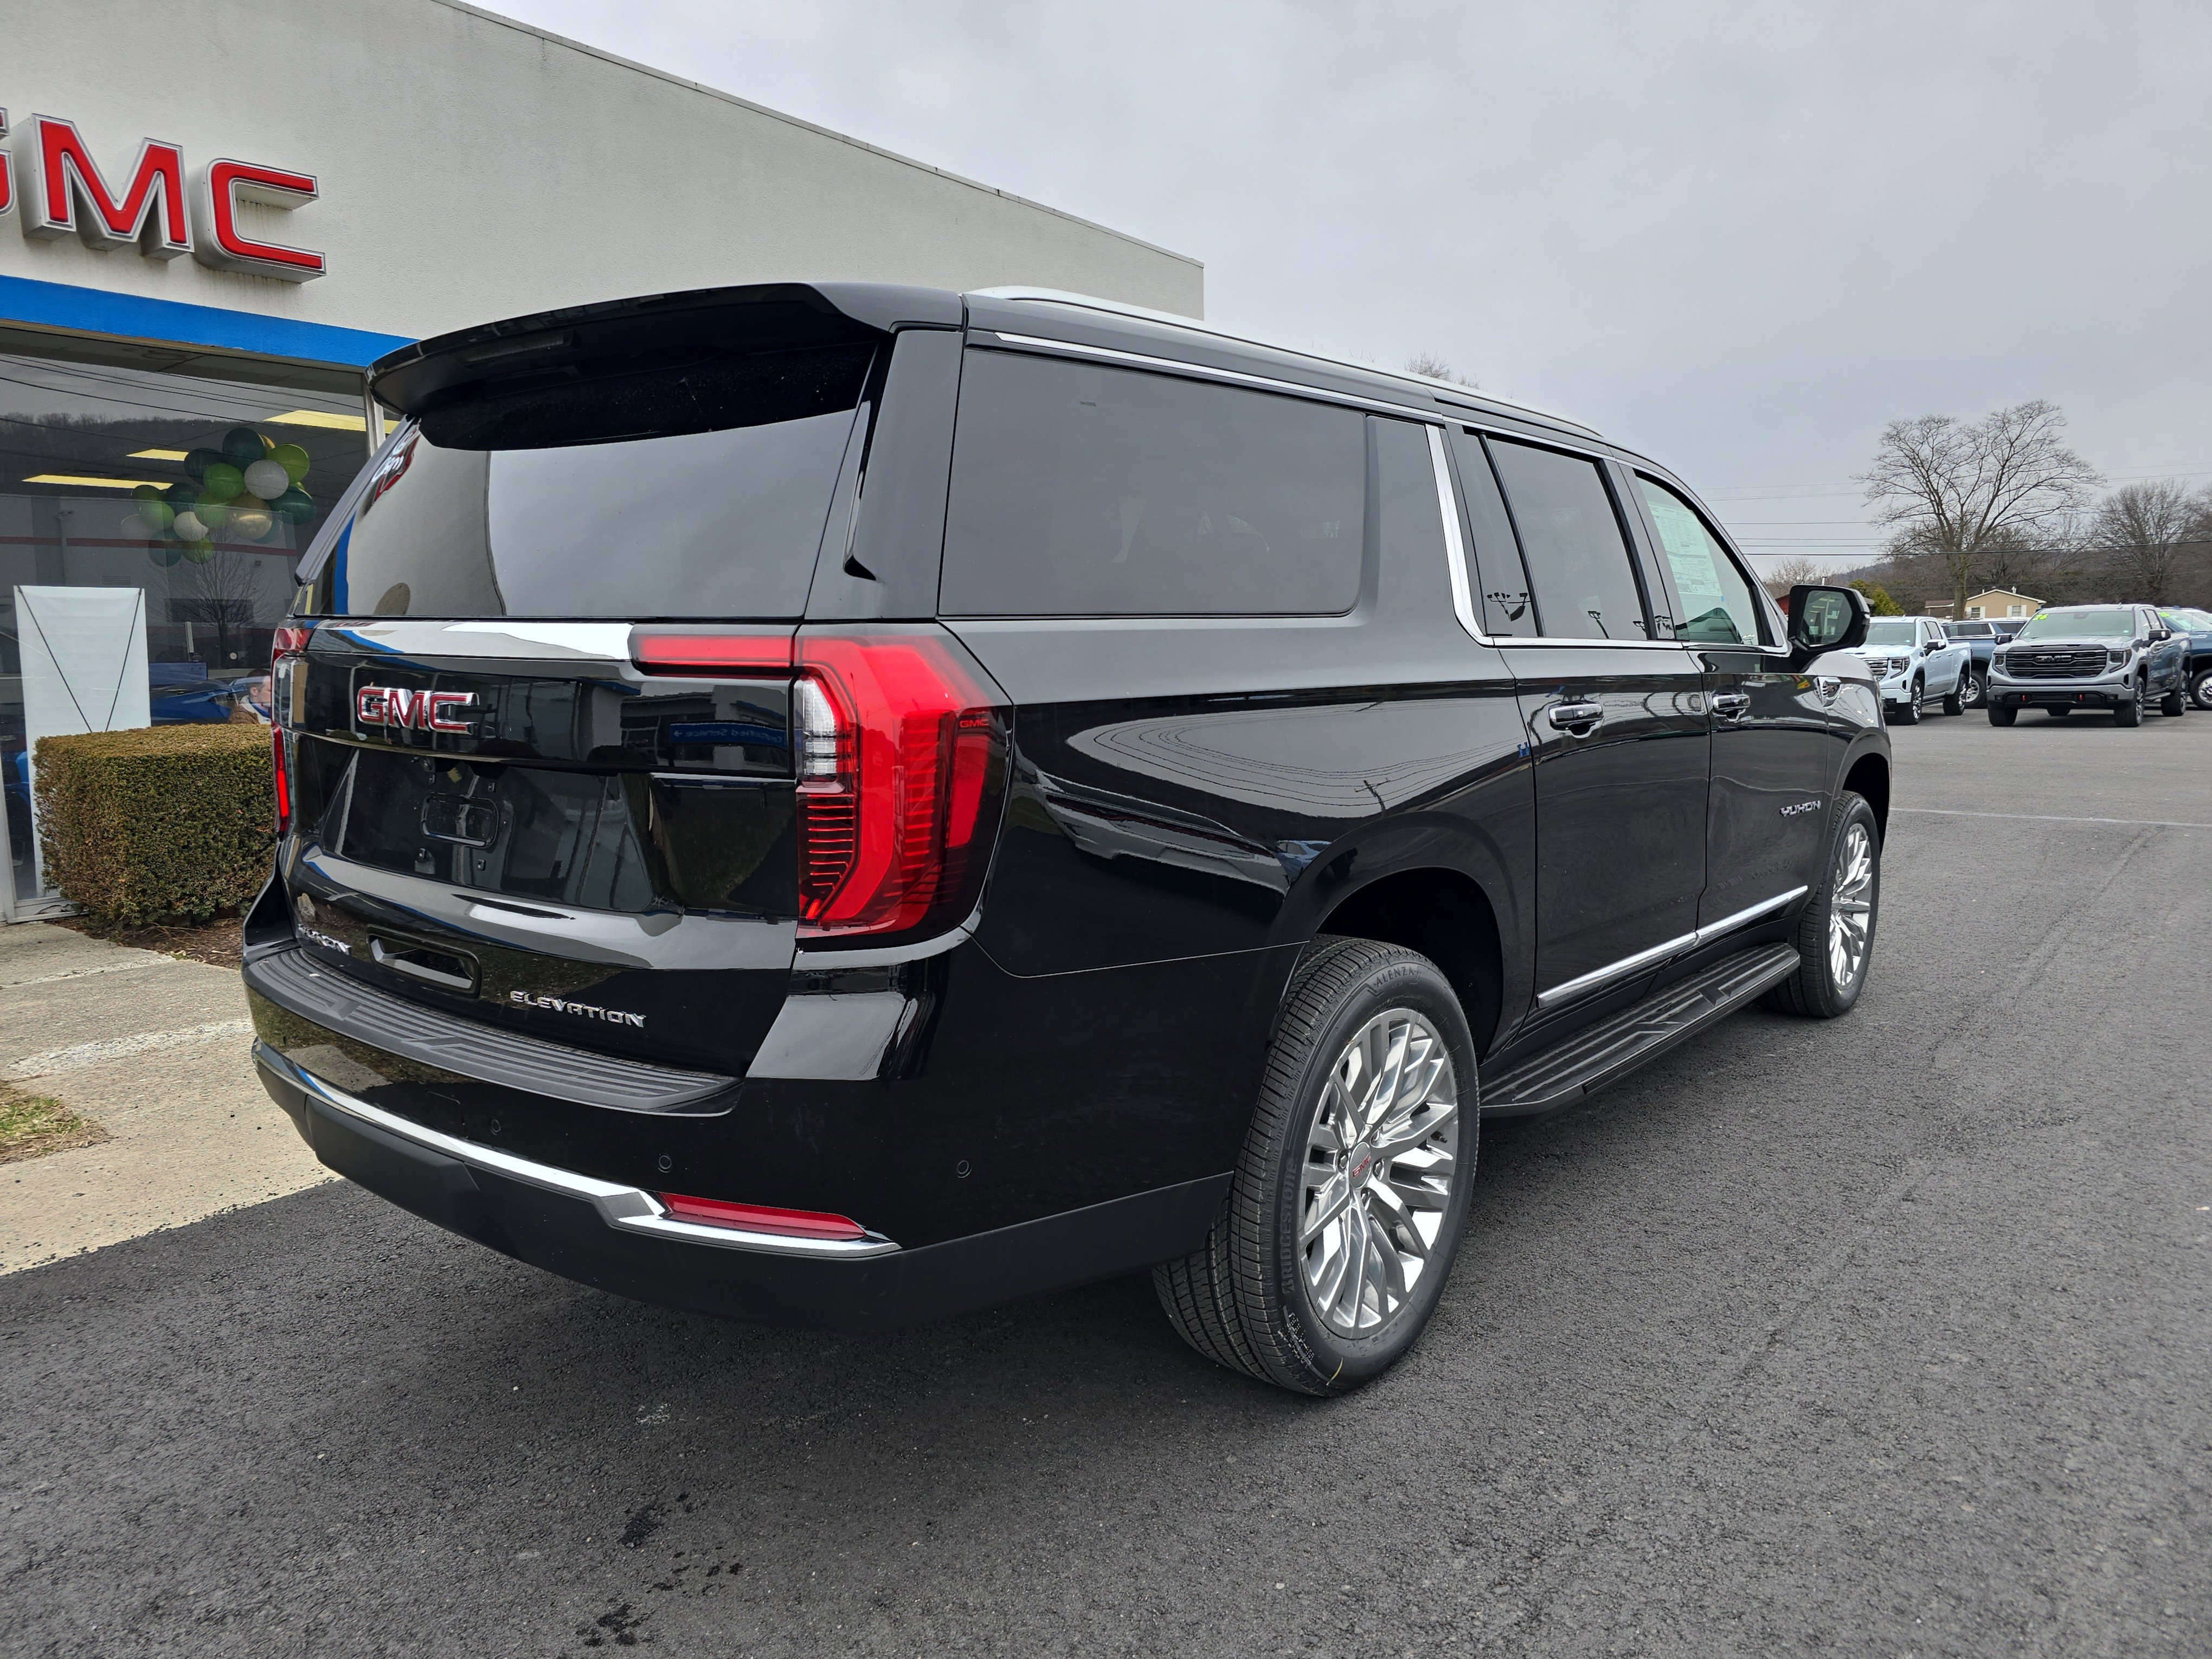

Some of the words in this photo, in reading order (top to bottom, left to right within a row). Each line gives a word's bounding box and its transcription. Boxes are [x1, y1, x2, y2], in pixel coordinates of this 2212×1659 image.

[0, 107, 326, 276] MC
[357, 686, 480, 735] GMC
[959, 718, 989, 728] GMC
[1779, 800, 1821, 817] YUKON
[1376, 966, 1416, 987] ALENZA
[510, 990, 647, 1028] ELEVATION
[1352, 1152, 1372, 1178] GMC
[1279, 1159, 1297, 1295] BRIDGESTONE
